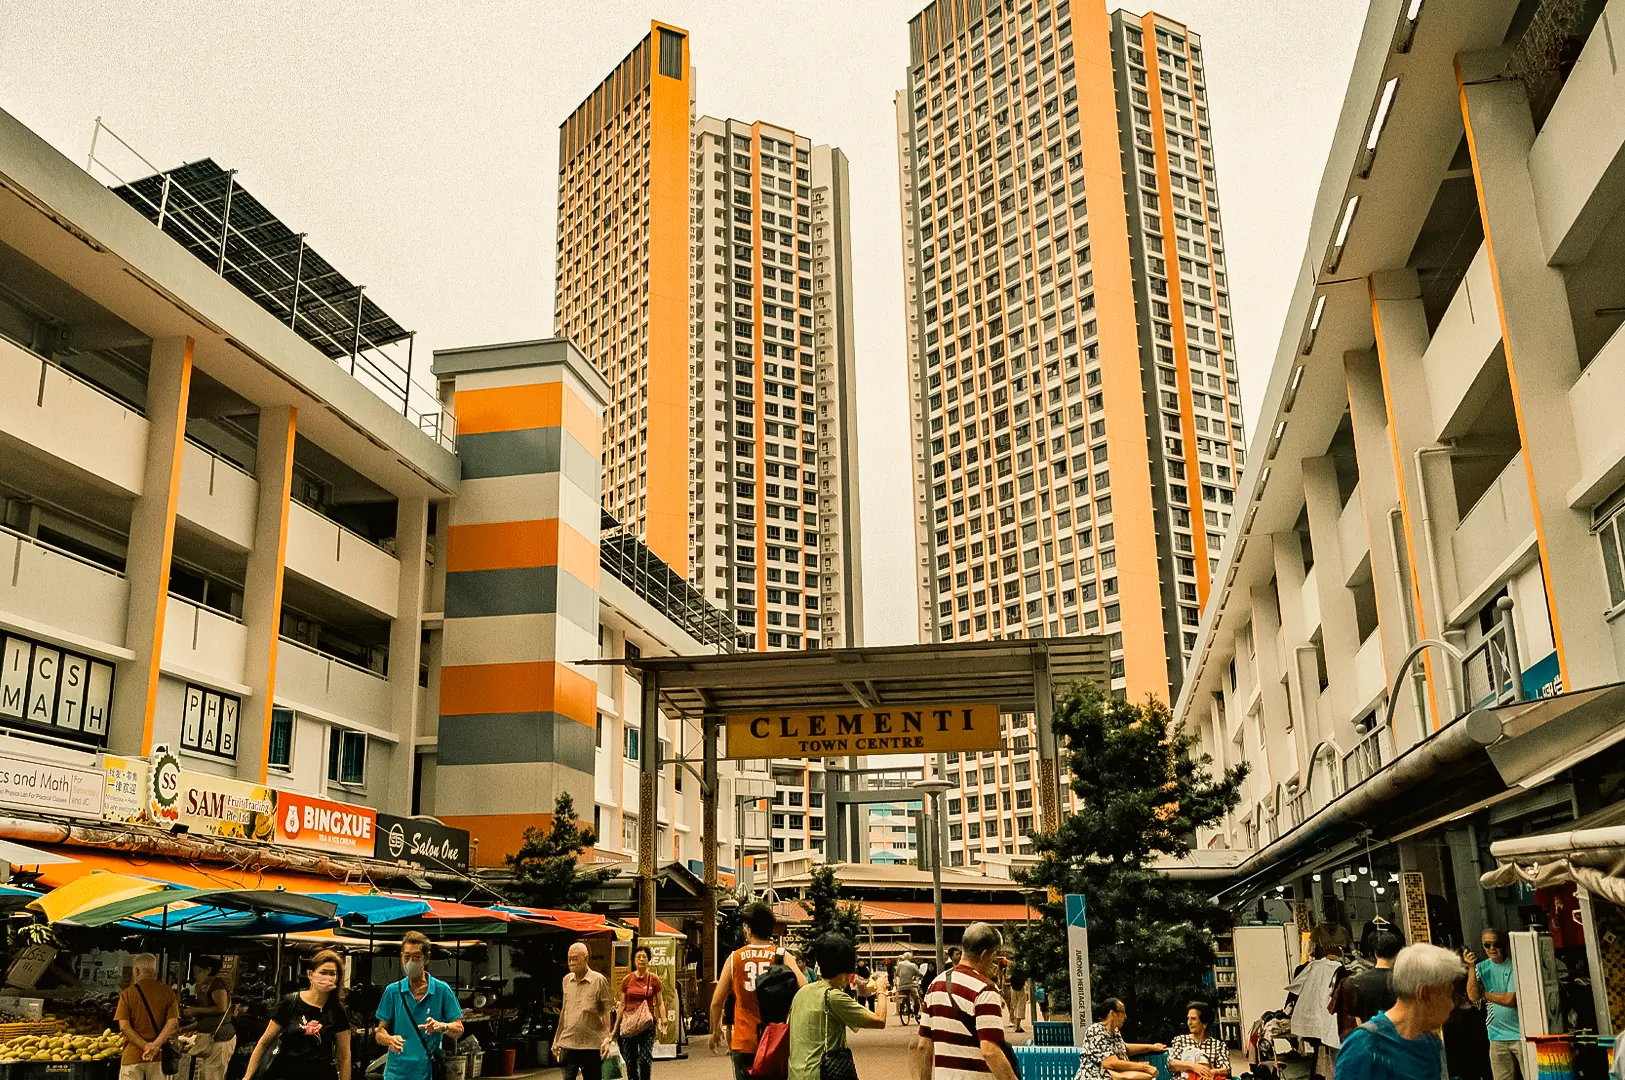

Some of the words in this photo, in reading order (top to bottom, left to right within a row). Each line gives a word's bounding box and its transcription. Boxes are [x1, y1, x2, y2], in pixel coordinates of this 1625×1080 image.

[14, 649, 80, 687] ICS
[3, 684, 103, 729] MATH
[190, 695, 234, 722] PHY
[188, 724, 232, 750] LAB
[750, 709, 974, 739] CLEMENTI
[798, 739, 847, 752] TOWN
[855, 736, 924, 750] CENTRE
[14, 770, 37, 787] and
[40, 773, 69, 792] Math
[162, 772, 177, 791] SS
[186, 788, 226, 819] SAM
[226, 810, 237, 822] Pte
[238, 812, 250, 824] Ltd
[227, 796, 243, 808] Fruit
[244, 798, 269, 814] Trading
[304, 805, 372, 839] BINGXUE
[410, 832, 440, 858] Salon
[441, 838, 459, 860] One
[648, 956, 675, 966] EAM
[740, 949, 776, 961] DURANT
[1075, 949, 1083, 977] JURONG
[1077, 977, 1085, 1009] HERITAGE
